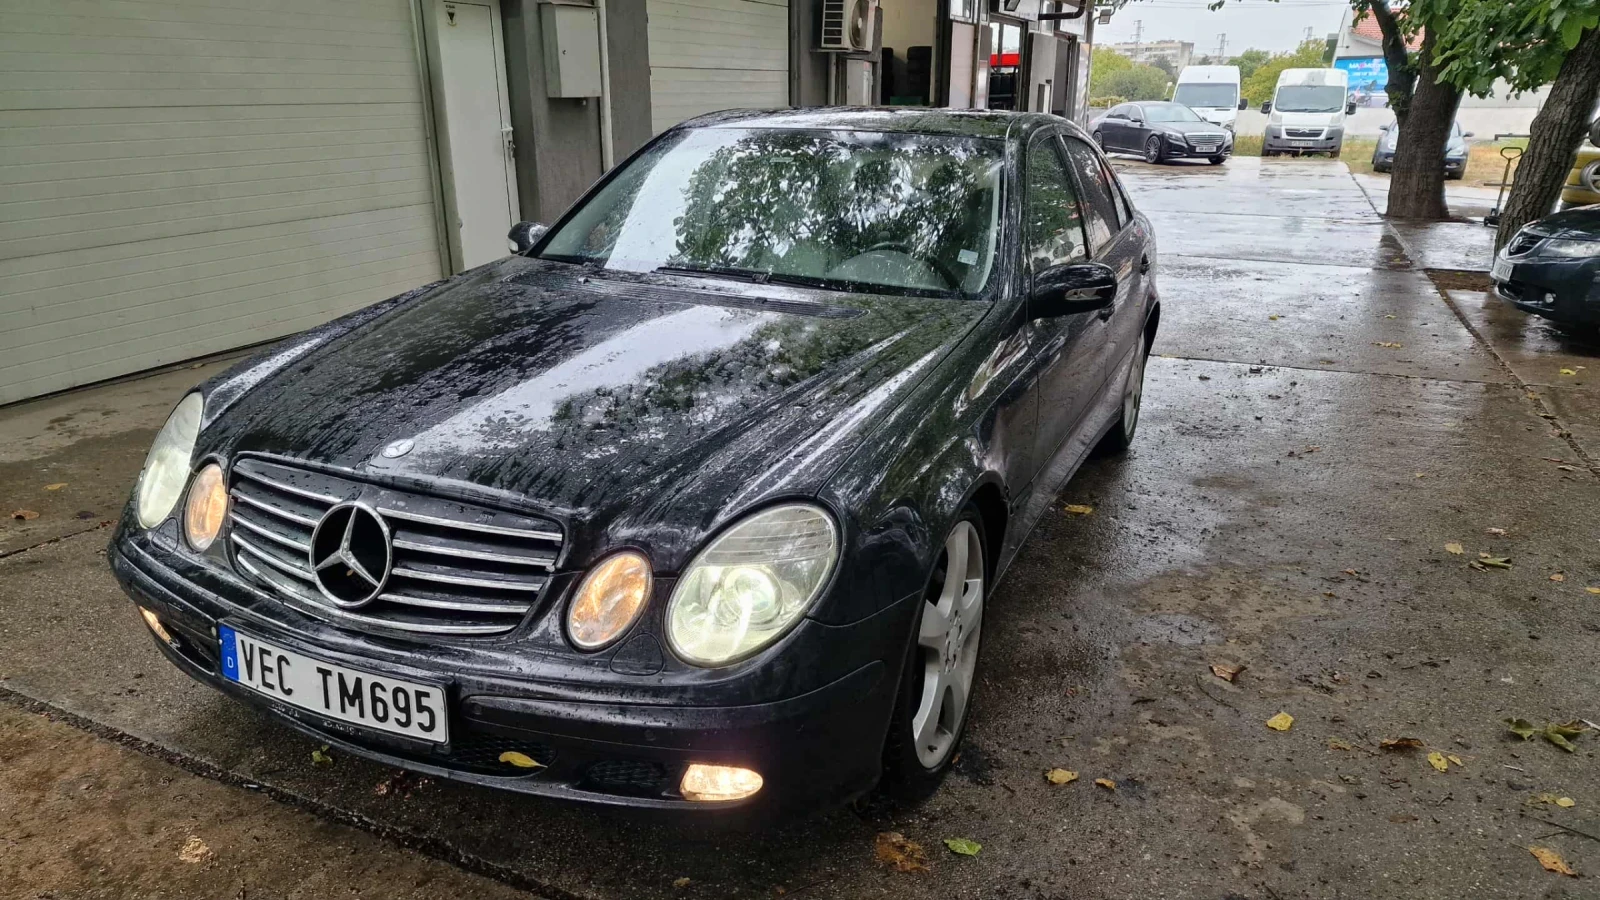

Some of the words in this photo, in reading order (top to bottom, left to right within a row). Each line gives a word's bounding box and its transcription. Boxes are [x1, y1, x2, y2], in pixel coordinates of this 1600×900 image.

[227, 656, 234, 668] D
[240, 639, 293, 696] VEC
[316, 666, 436, 733] TM695
